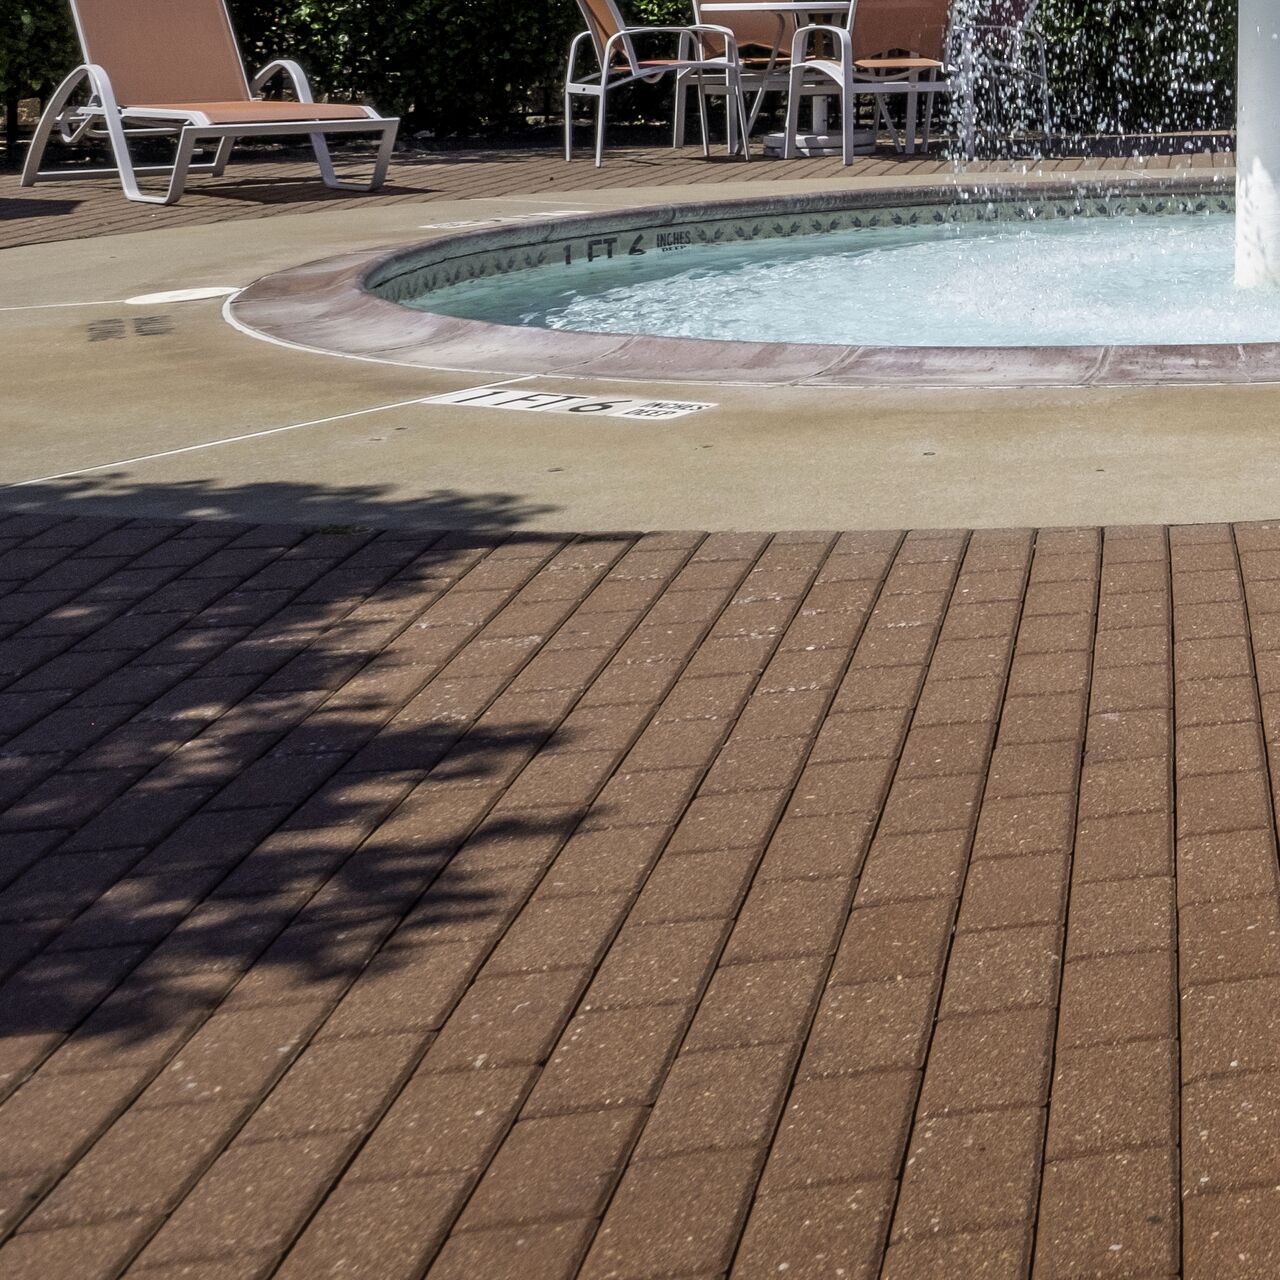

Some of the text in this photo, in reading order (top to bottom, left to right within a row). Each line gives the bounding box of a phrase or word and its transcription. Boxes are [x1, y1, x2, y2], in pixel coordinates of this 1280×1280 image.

[562, 230, 691, 265] 1 FT 6 INCHES
[452, 390, 711, 412] 1 FT 6 INCHES
[622, 408, 675, 417] DEEP
